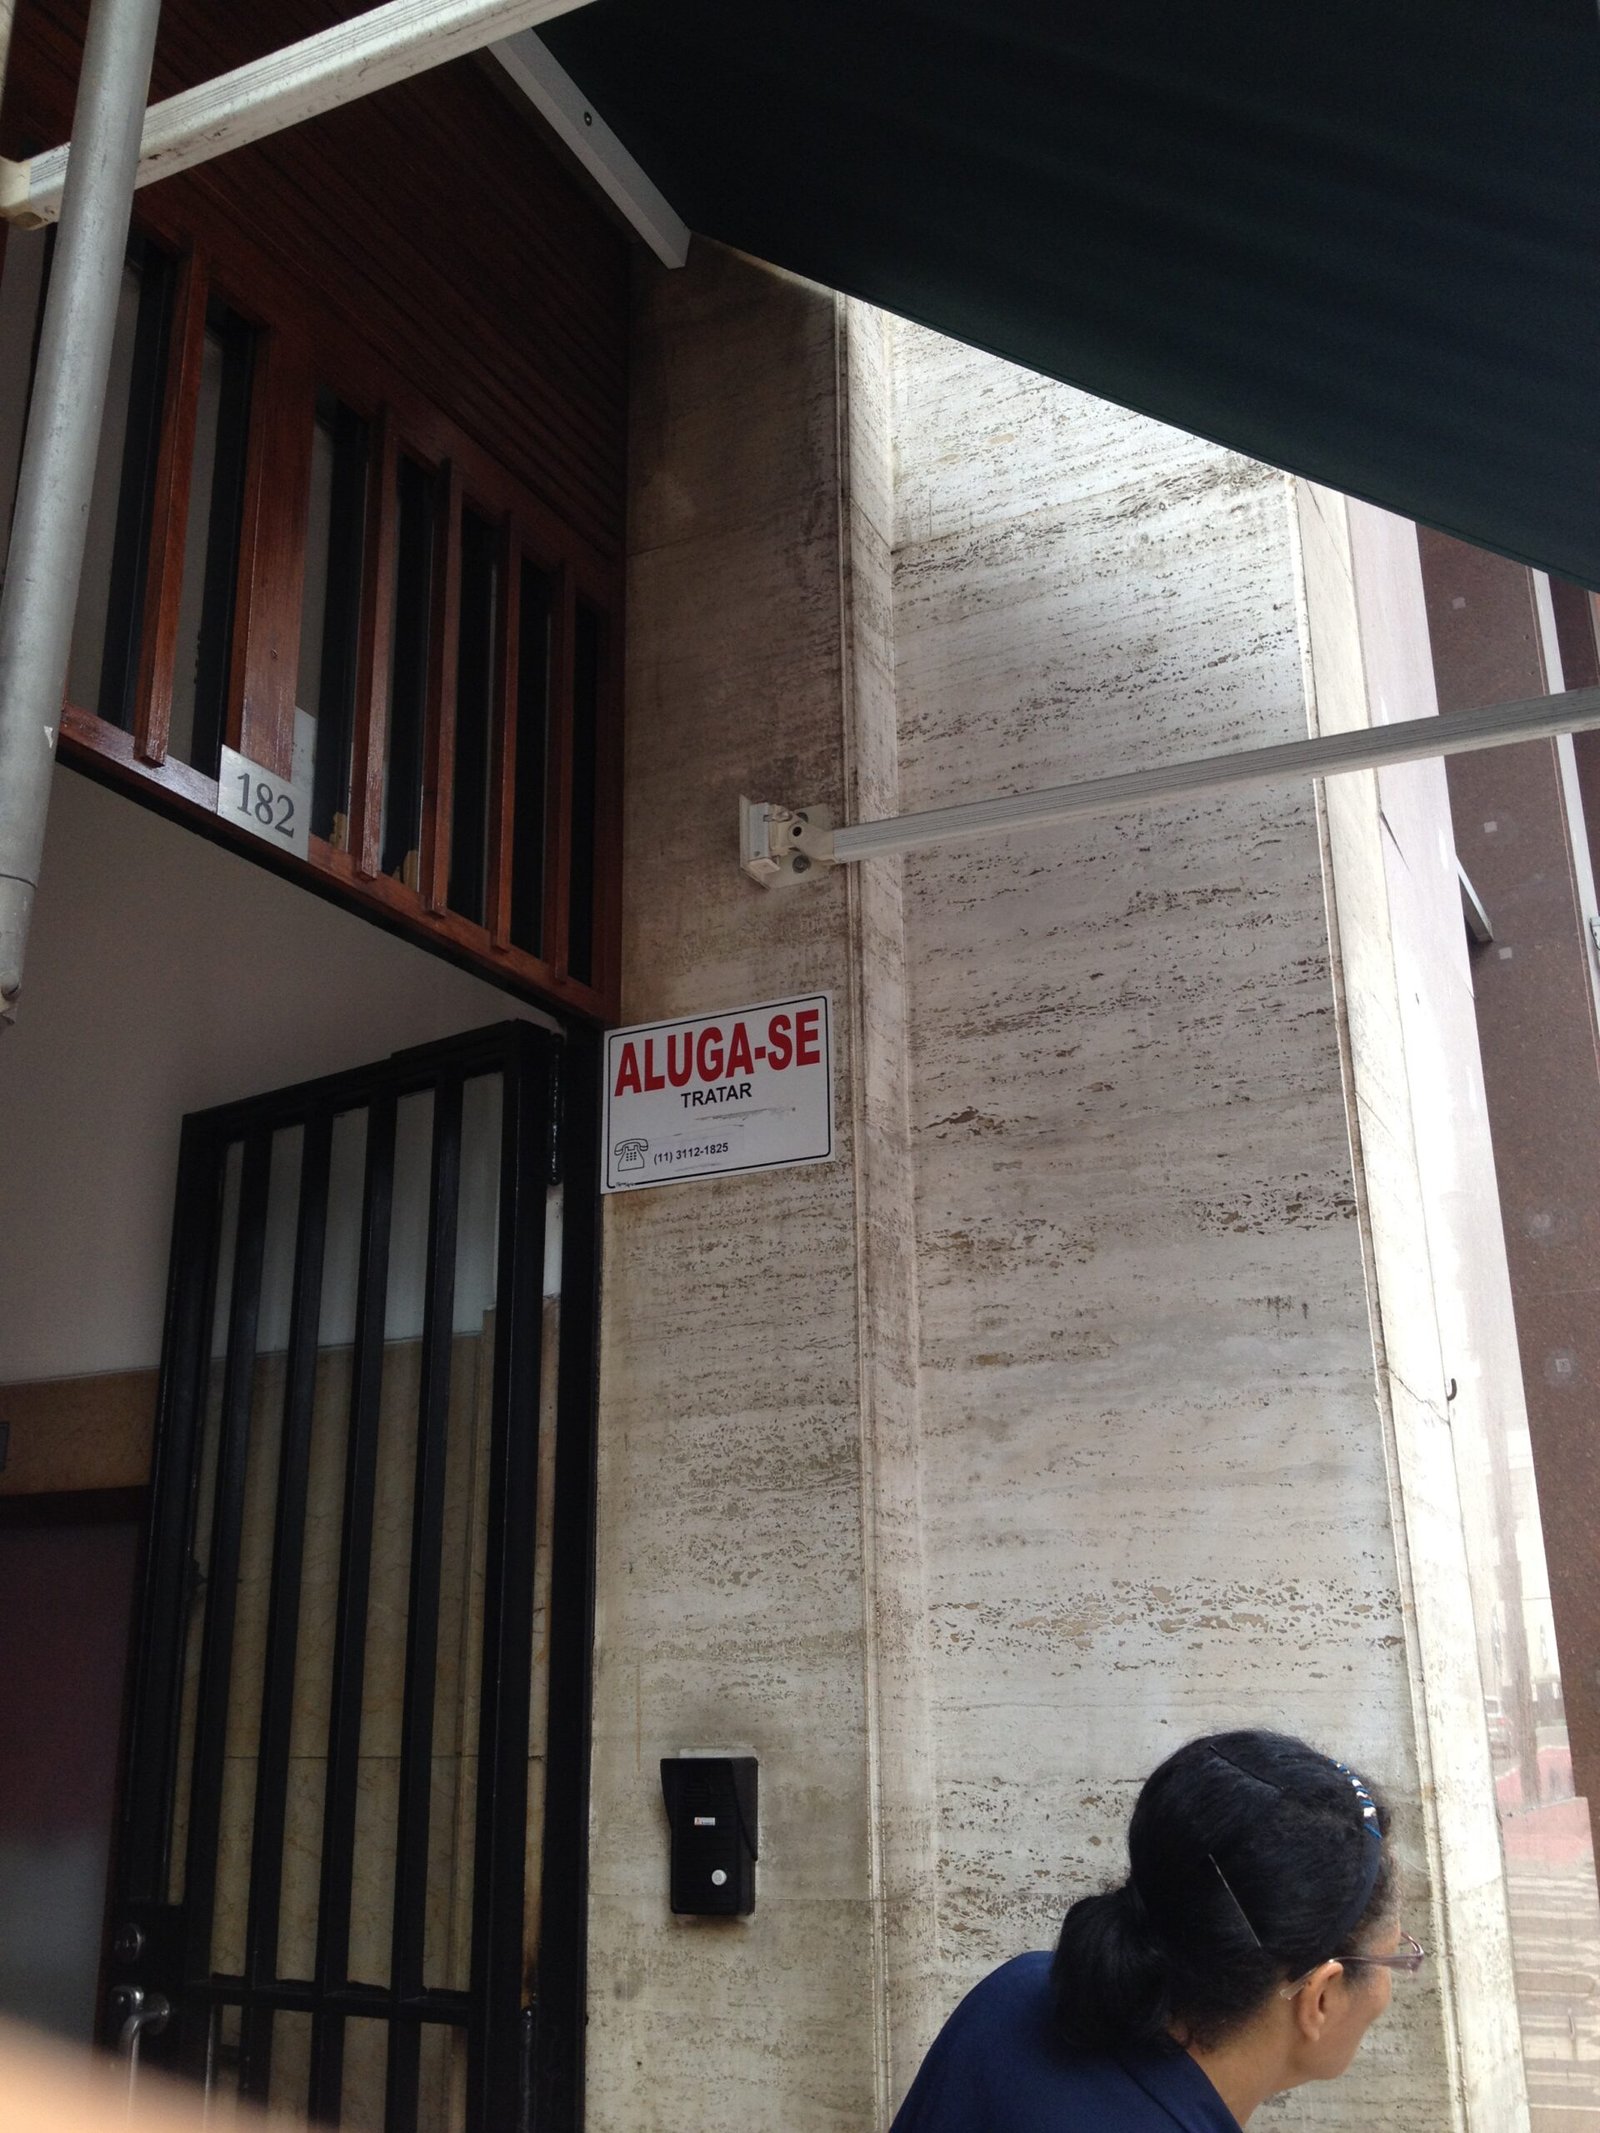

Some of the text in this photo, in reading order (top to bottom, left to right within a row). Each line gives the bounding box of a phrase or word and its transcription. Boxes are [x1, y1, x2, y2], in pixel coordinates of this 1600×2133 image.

[237, 773, 295, 839] 182
[614, 1008, 821, 1097] ALUGA-SE
[681, 1082, 753, 1109] TRATAR
[653, 1142, 729, 1166] (11) 3112-1825
